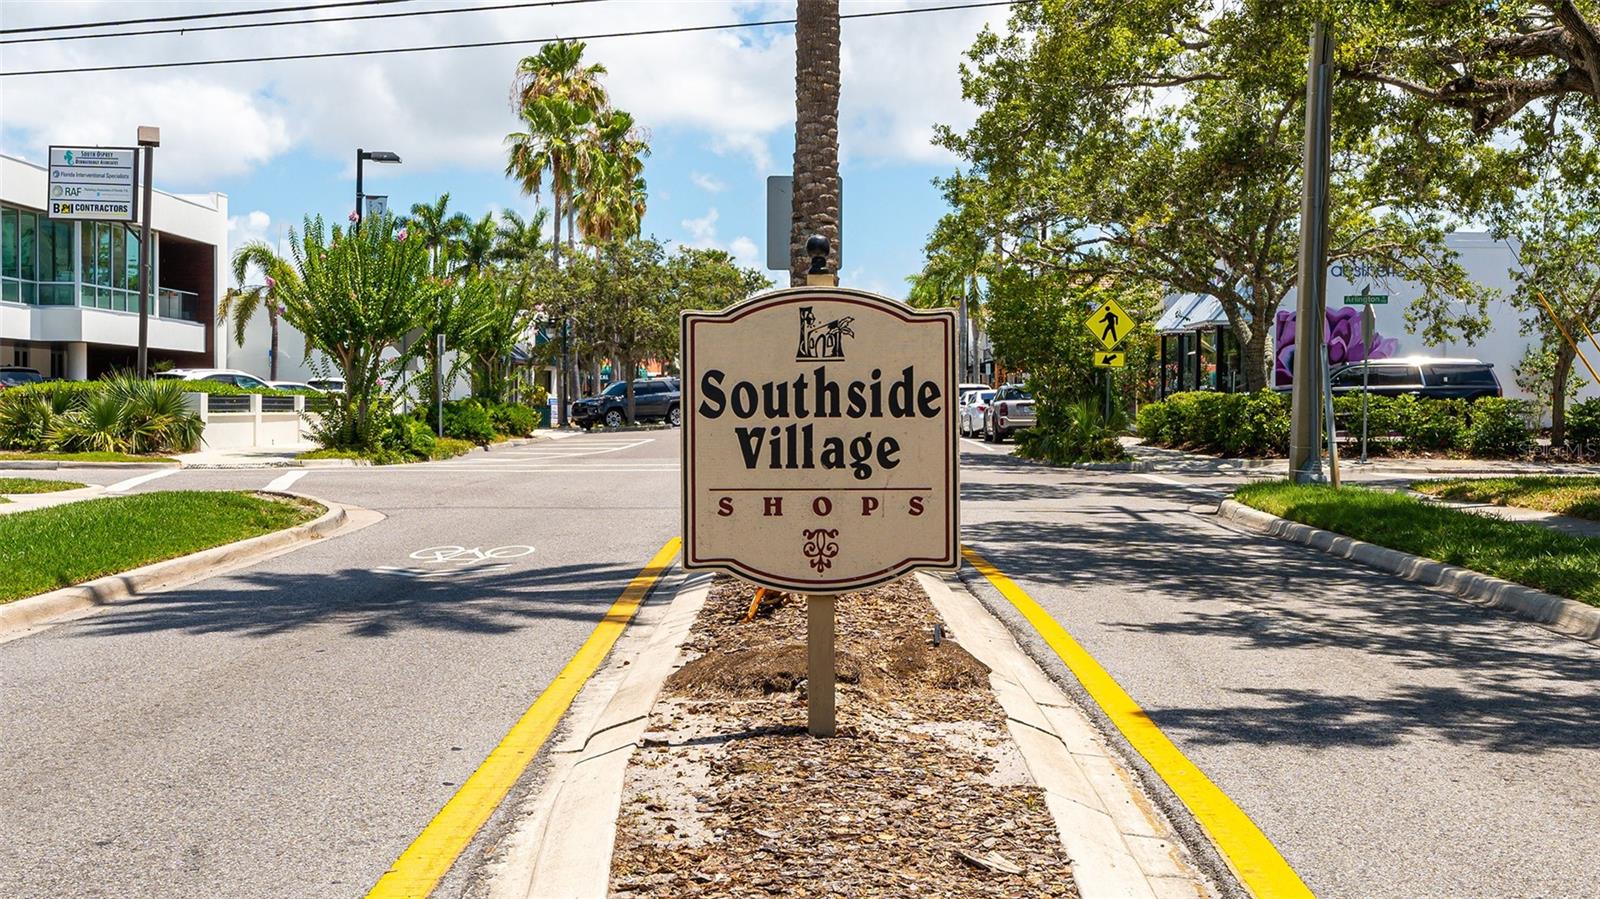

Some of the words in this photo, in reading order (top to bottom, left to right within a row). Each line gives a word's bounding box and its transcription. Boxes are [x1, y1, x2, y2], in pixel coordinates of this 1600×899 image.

[65, 187, 82, 196] RAF
[75, 203, 128, 213] CONTRACTORS
[1346, 296, 1380, 304] Arlington
[698, 366, 942, 419] Southside
[735, 423, 901, 480] Village
[717, 496, 925, 517] SHOPS
